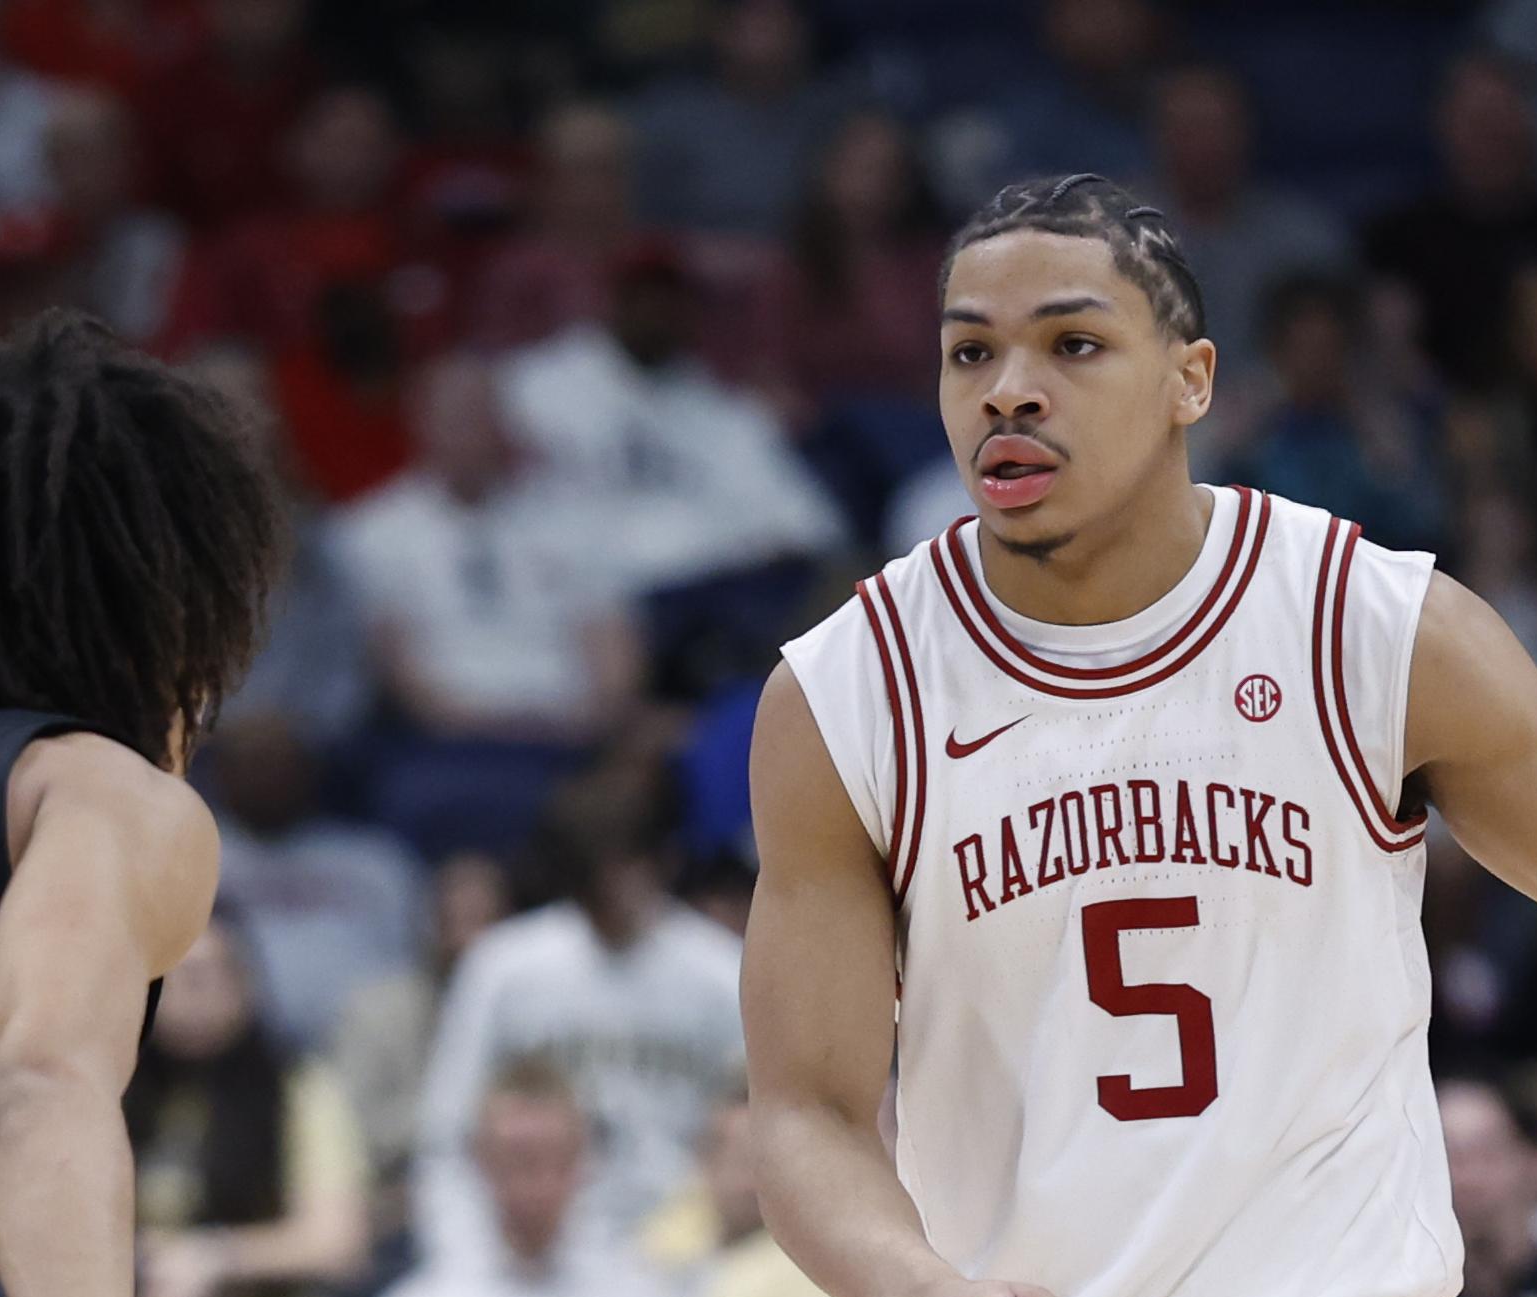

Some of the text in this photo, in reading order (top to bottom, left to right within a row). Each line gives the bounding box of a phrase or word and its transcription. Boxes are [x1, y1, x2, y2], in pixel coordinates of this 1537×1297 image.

[1237, 676, 1280, 720] SEC
[952, 779, 1313, 922] RAZORBACKS
[1081, 896, 1219, 1122] 5
